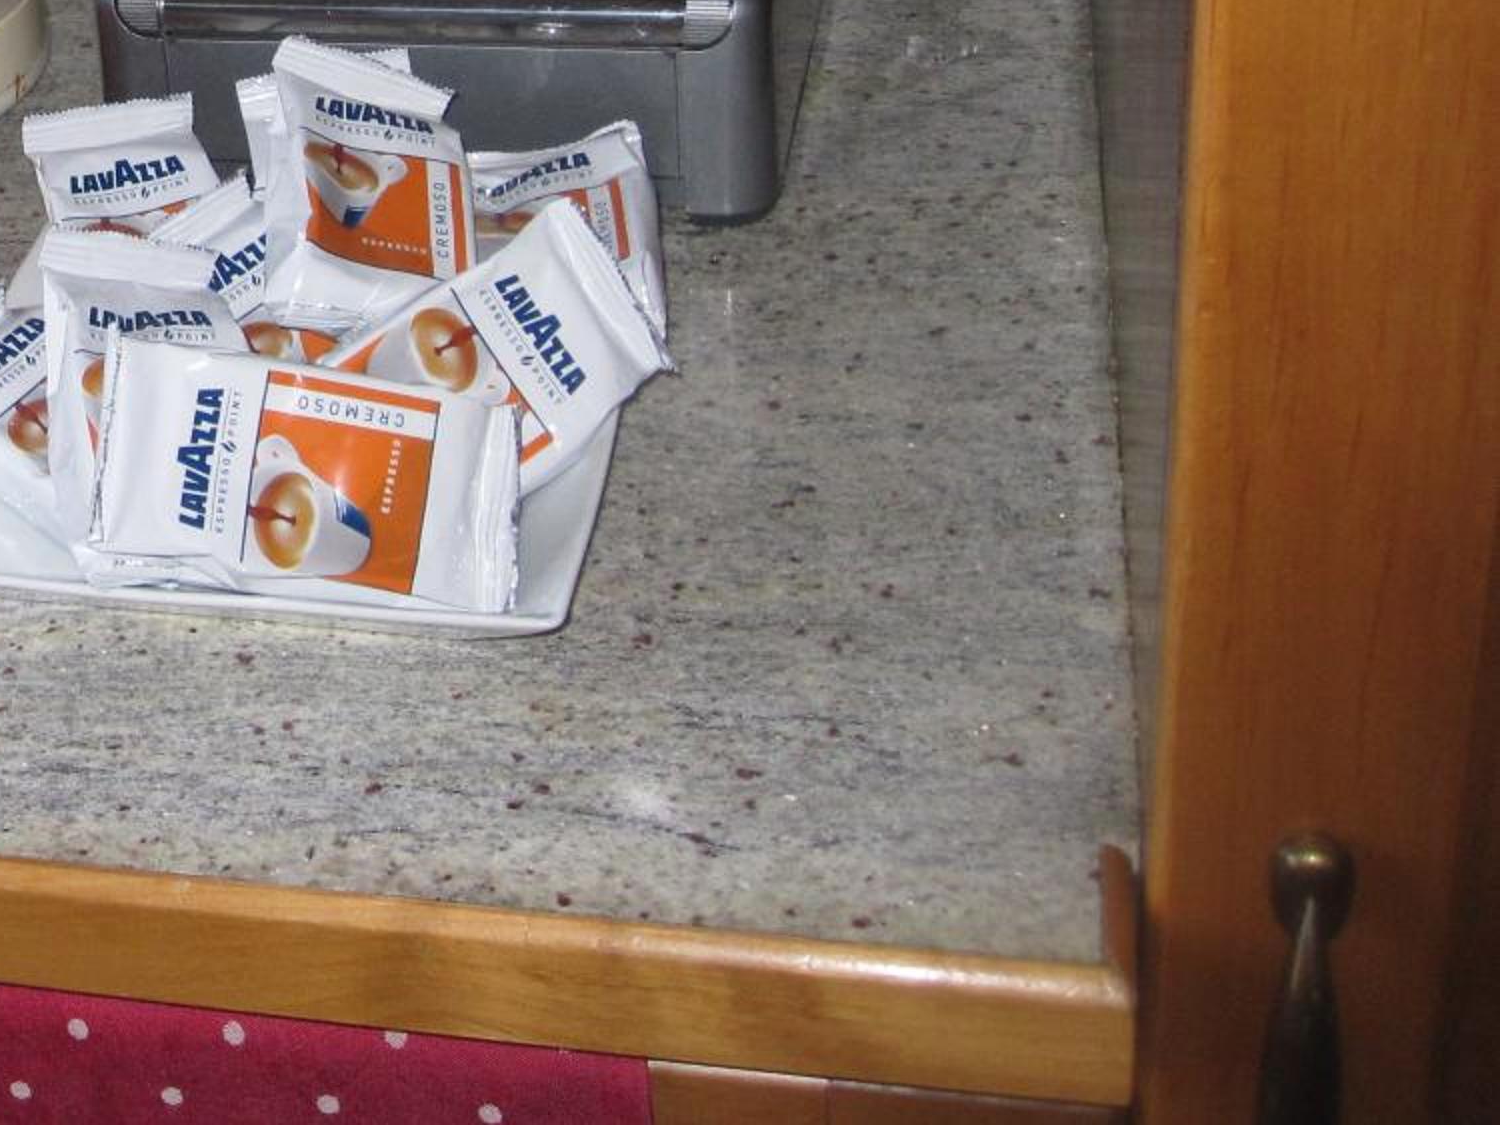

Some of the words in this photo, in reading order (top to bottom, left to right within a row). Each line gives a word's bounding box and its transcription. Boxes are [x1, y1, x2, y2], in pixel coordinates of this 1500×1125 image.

[315, 96, 433, 135] LAVAZZA
[315, 115, 380, 137] ESPRESSO
[397, 132, 437, 148] POINT
[70, 155, 186, 195] LAVAZZA
[72, 191, 137, 206] ESPRESSO
[153, 176, 190, 193] POINT
[361, 237, 428, 255] ESPRESSO
[432, 181, 450, 259] CREMOSO
[479, 289, 524, 353] ESPRESSO
[531, 366, 563, 404] POINT
[494, 274, 587, 396] LAVAZZA
[297, 394, 405, 428] CREMOSO
[177, 388, 224, 531] LAVAZZA
[215, 457, 231, 534] ESPRESSO
[228, 391, 243, 436] POINT
[380, 439, 402, 514] ESPRESSO
